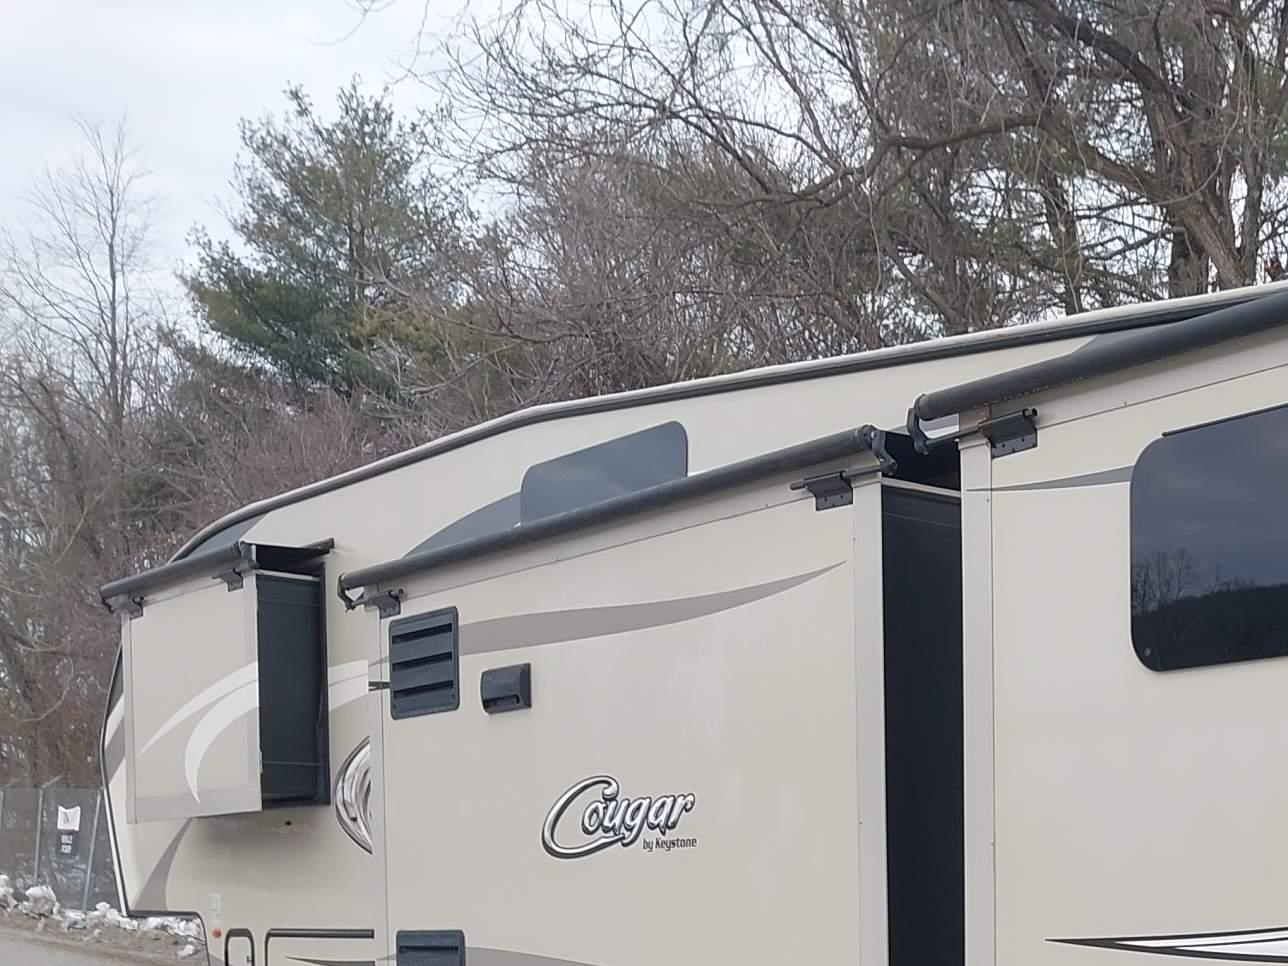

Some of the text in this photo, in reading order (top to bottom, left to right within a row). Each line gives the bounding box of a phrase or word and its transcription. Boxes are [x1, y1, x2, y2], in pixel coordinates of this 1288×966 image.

[541, 775, 695, 859] Cougar
[642, 837, 697, 852] by Keystone
